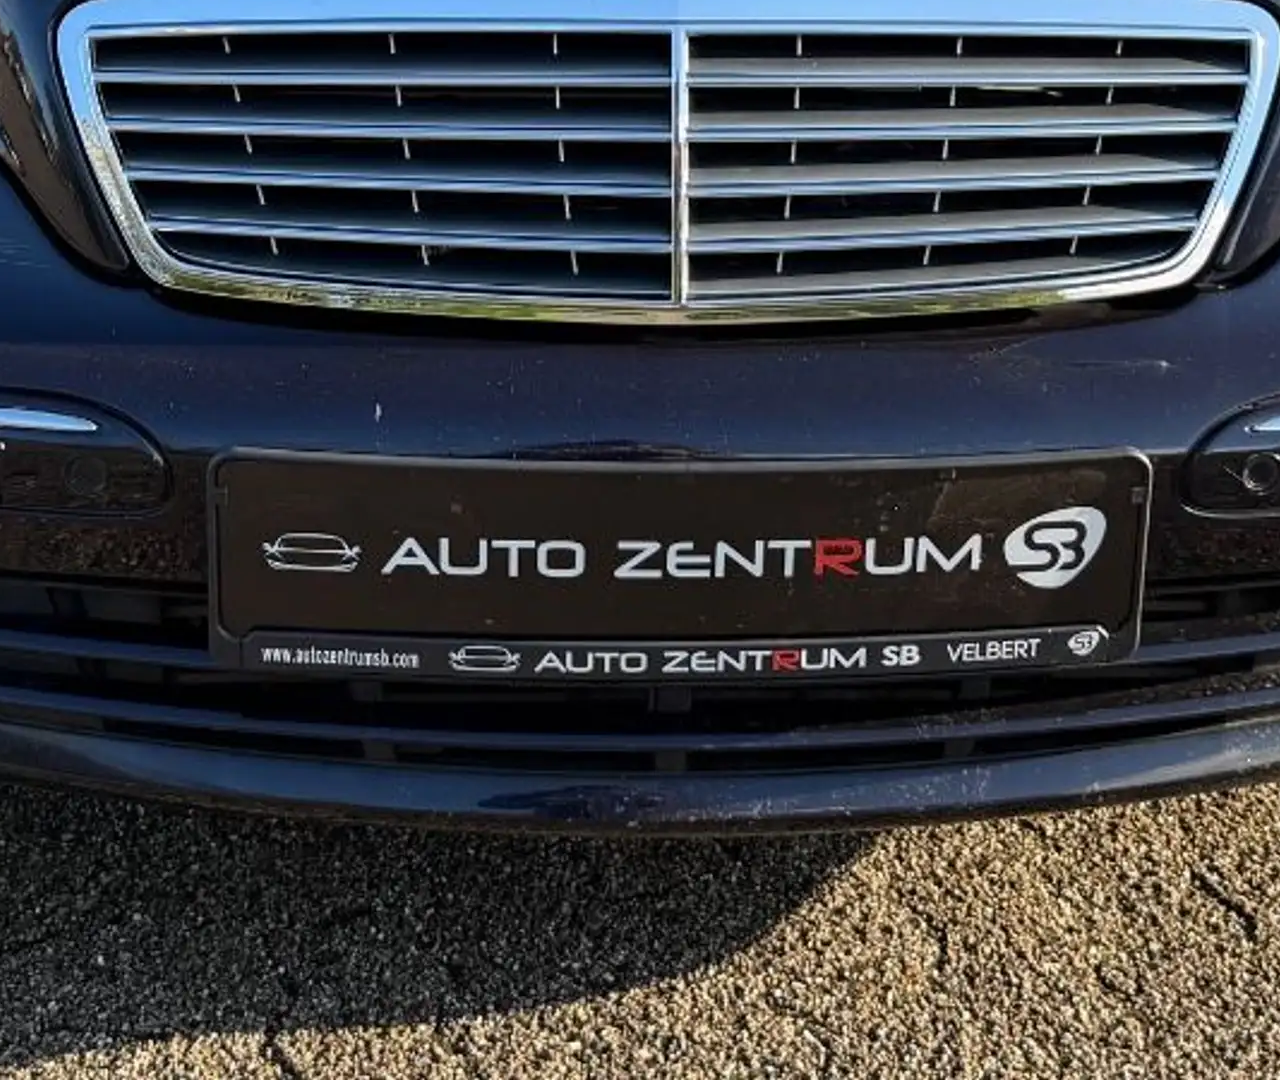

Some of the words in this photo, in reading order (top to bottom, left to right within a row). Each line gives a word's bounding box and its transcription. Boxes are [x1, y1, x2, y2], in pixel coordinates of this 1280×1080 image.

[381, 537, 587, 579] AUTO
[613, 533, 984, 580] ZENTRUM
[260, 645, 420, 669] www.autozentrumsb.com
[534, 651, 648, 675] AUTO
[662, 647, 867, 673] ZENTRUM
[881, 644, 921, 668] SB
[946, 637, 1042, 663] VELBERT
